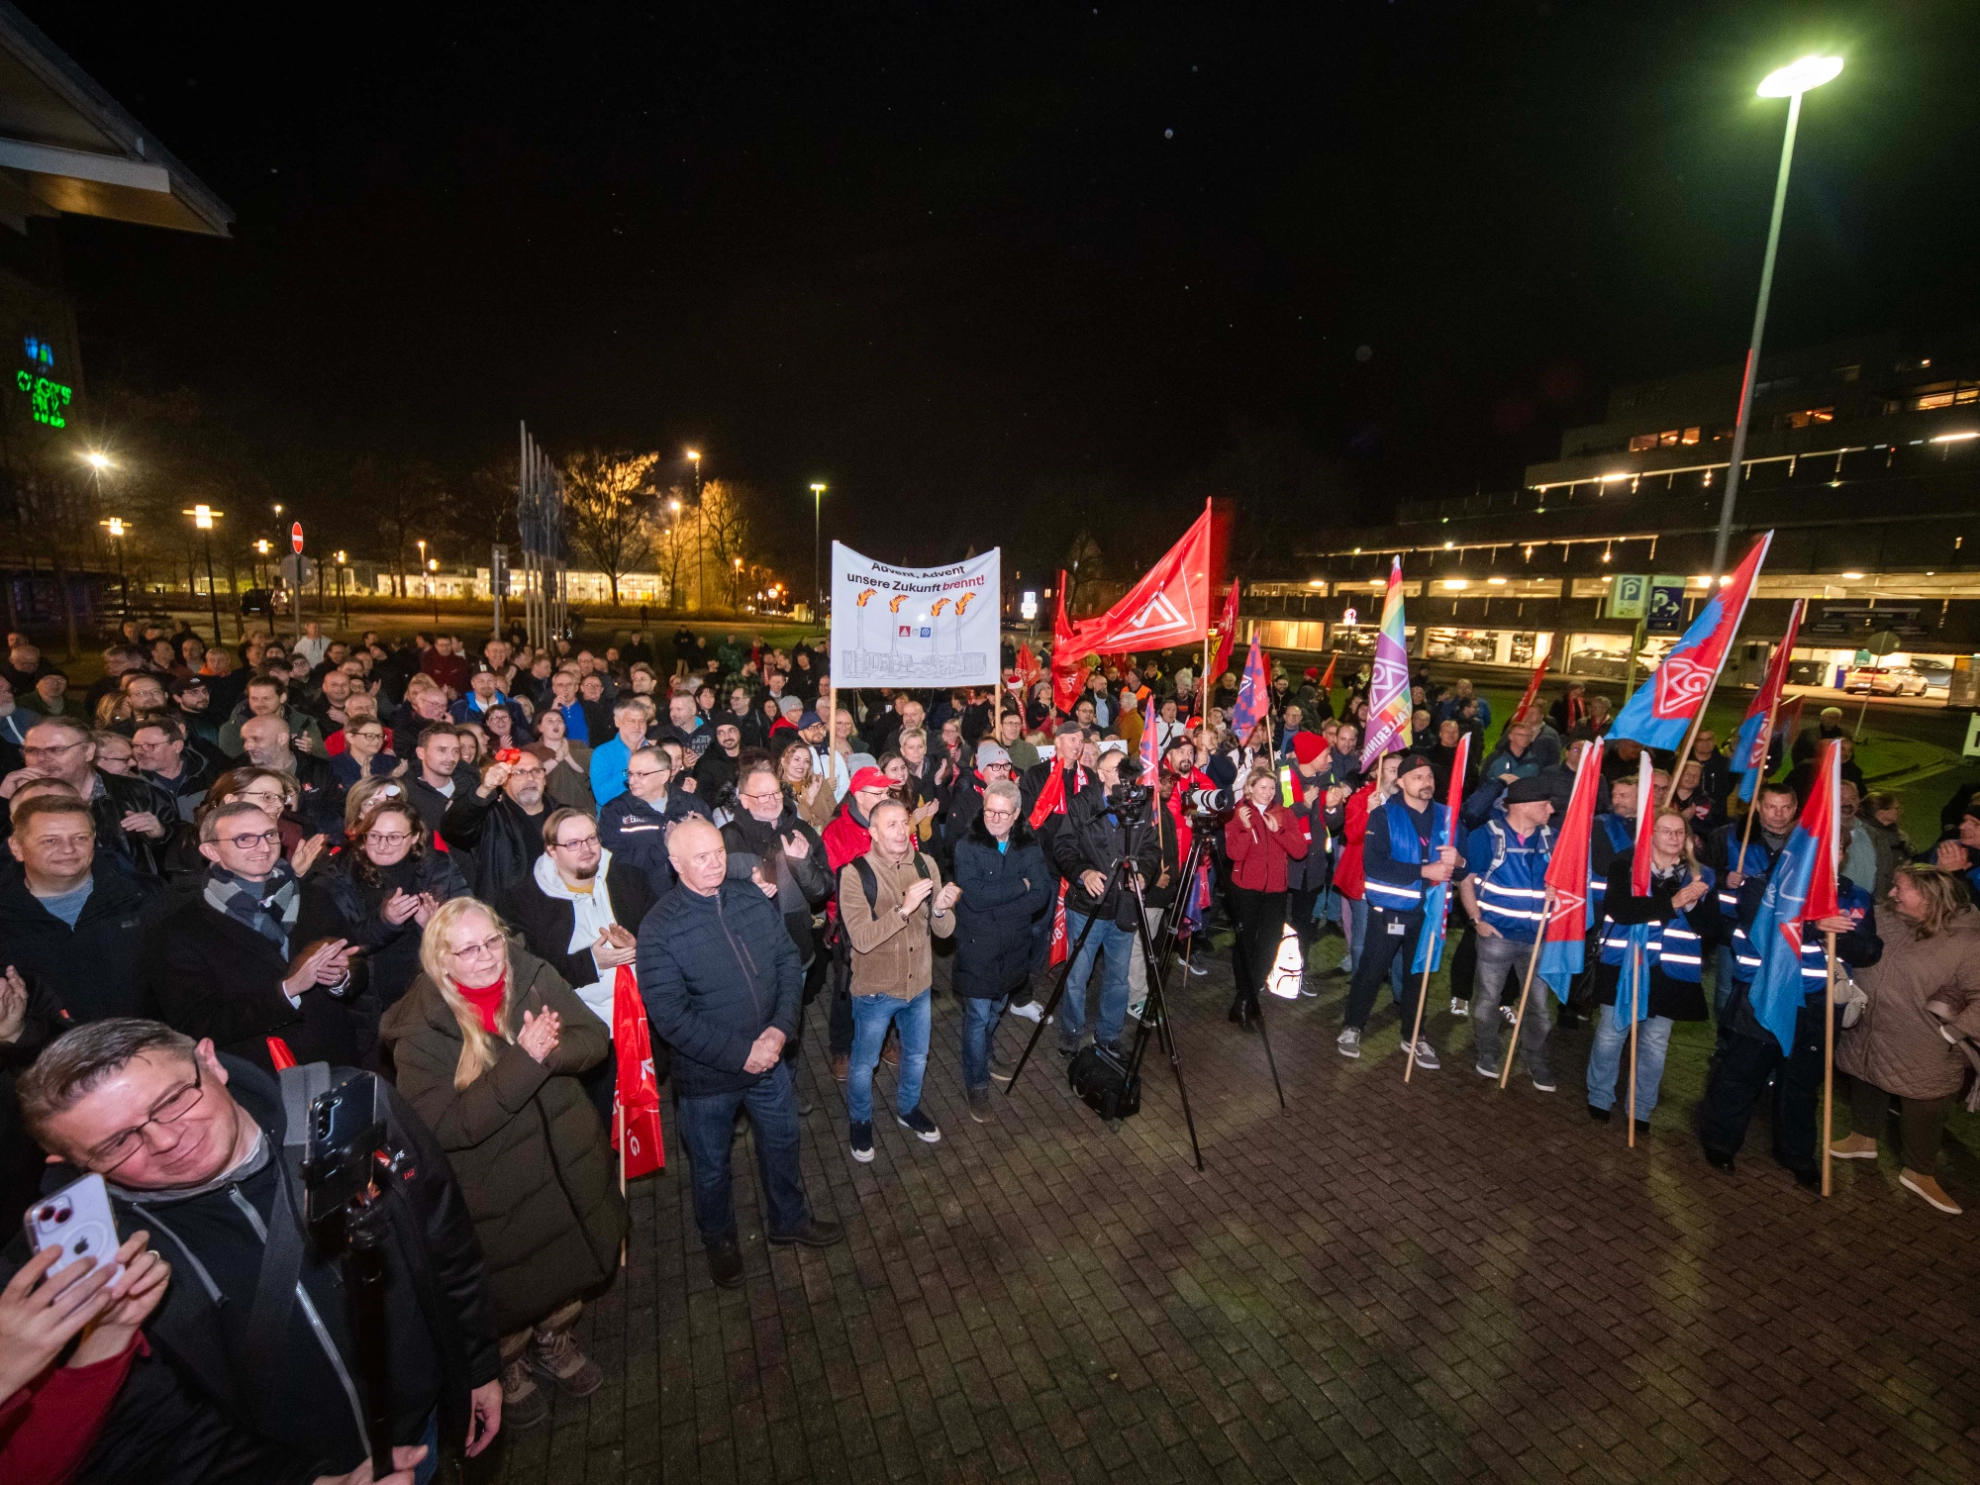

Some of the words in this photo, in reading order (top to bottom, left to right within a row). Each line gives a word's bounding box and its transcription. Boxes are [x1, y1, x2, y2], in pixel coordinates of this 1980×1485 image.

[871, 562, 917, 578] Advent,
[923, 565, 965, 578] Advent
[847, 573, 890, 589] unsere
[892, 580, 941, 593] Zukunft
[943, 575, 985, 591] brennt!
[1624, 583, 1637, 600] P
